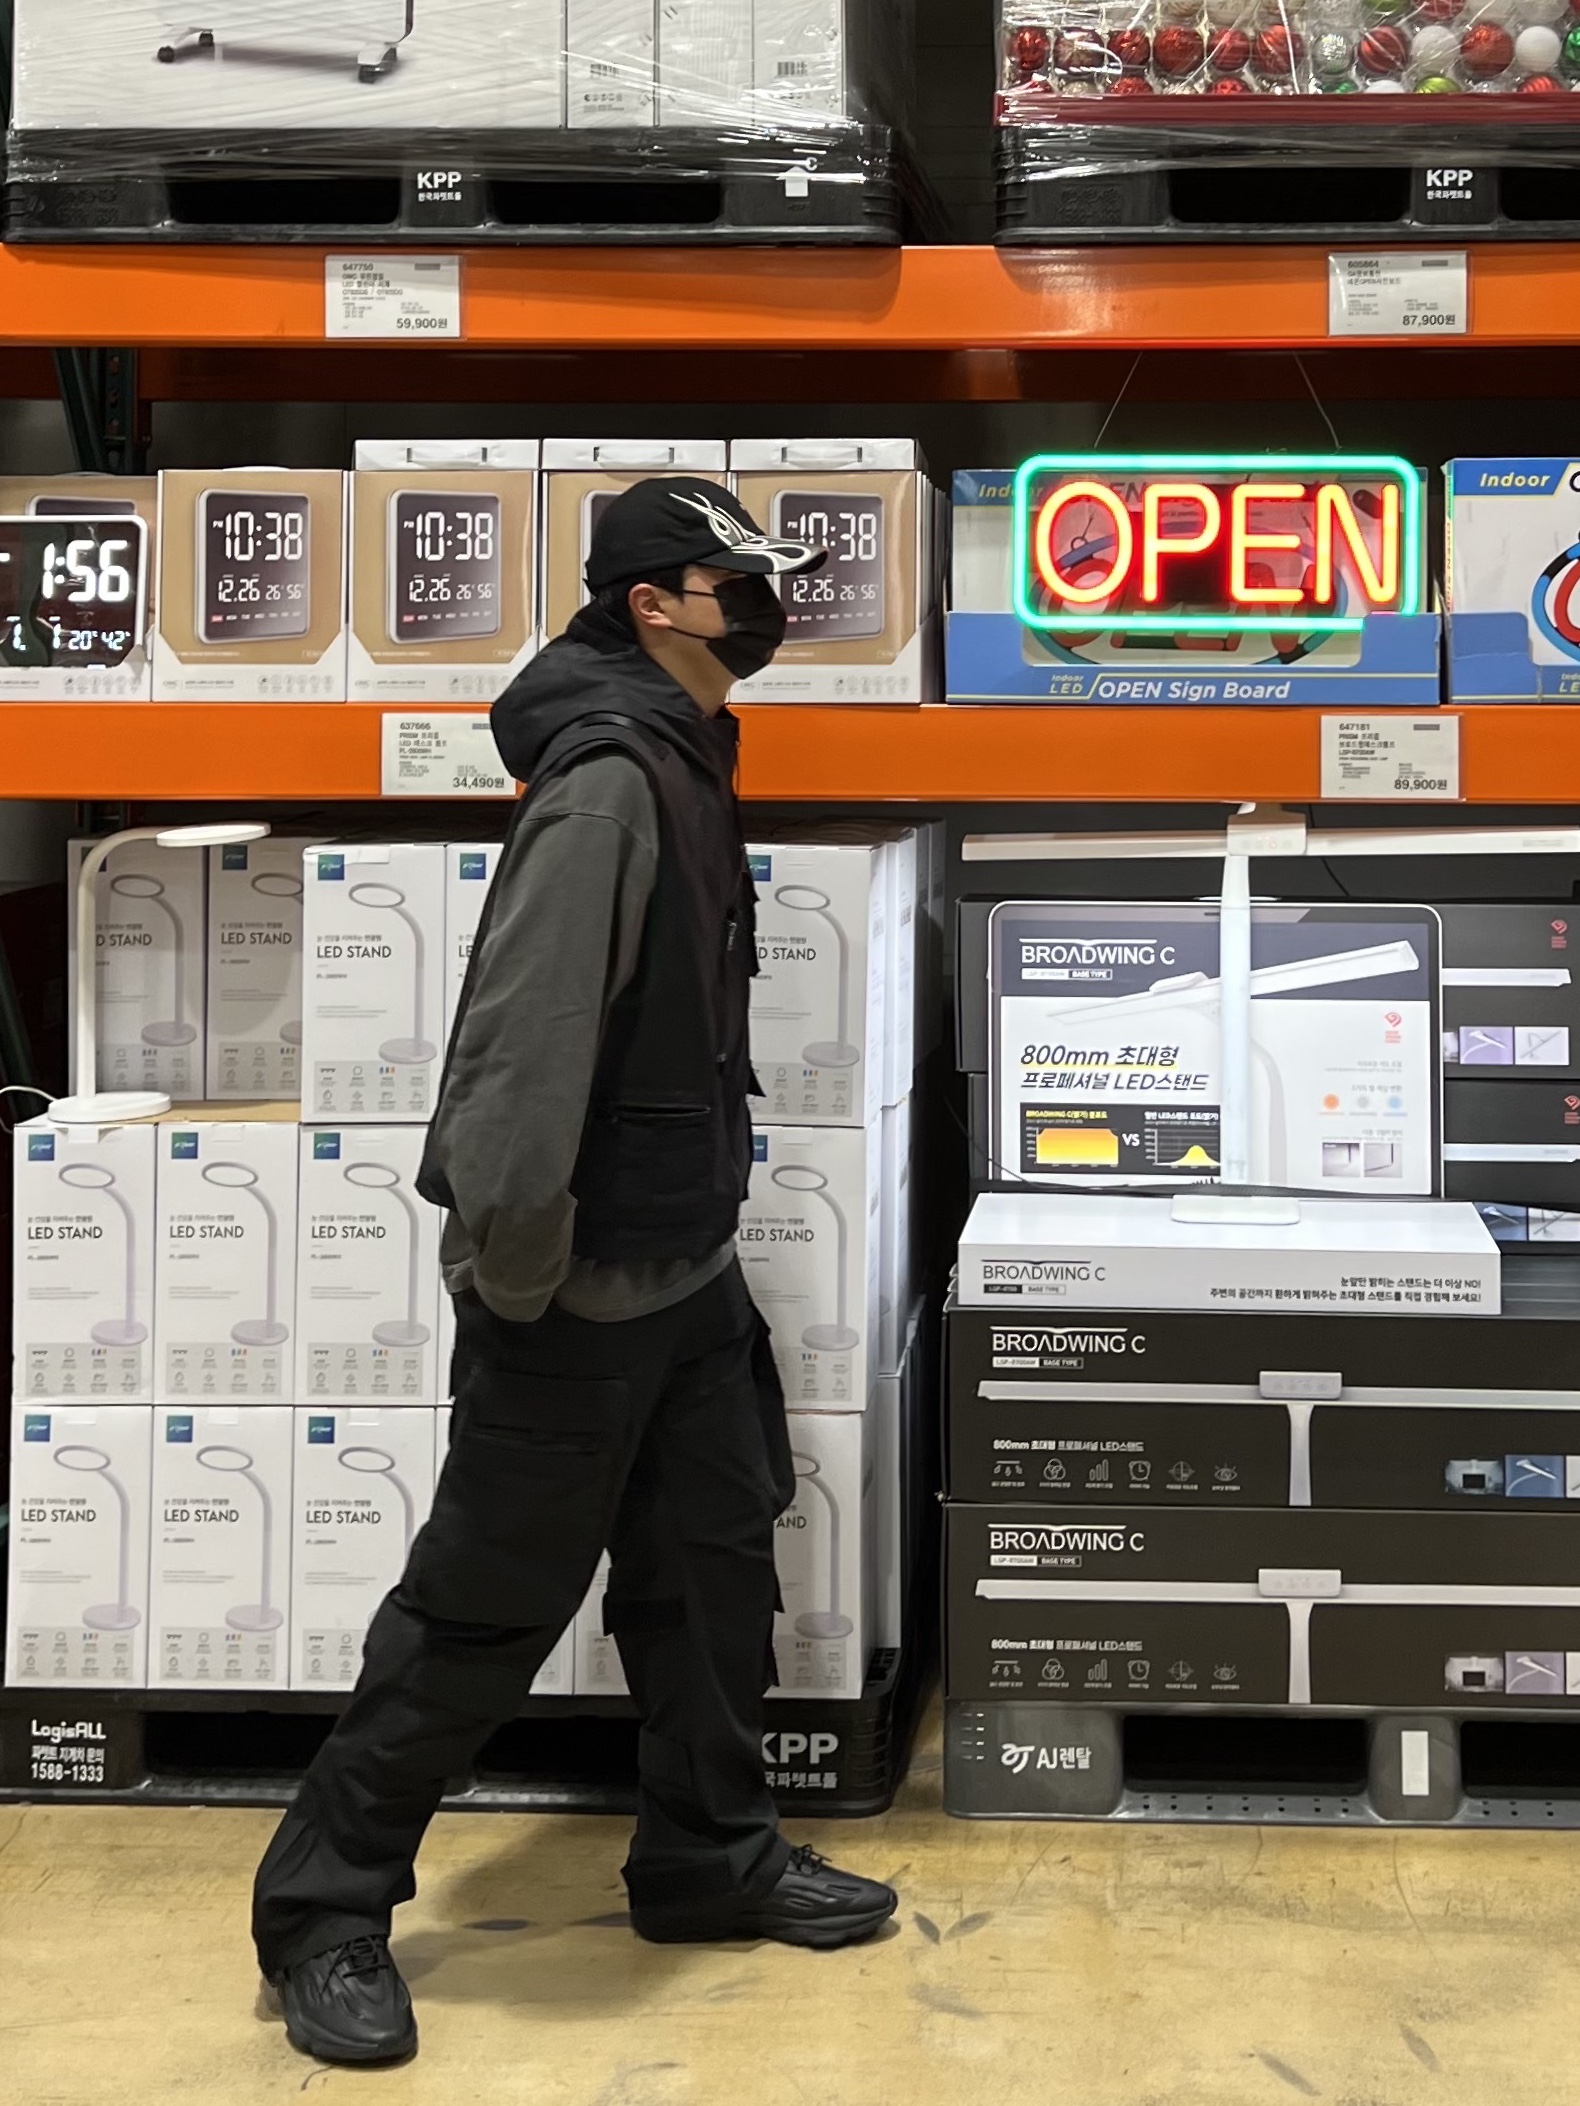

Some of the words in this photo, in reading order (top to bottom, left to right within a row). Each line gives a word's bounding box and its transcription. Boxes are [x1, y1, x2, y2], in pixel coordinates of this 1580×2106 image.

[417, 171, 462, 189] KPP
[1426, 169, 1473, 187] KPP
[396, 318, 448, 330] 59,900원
[1402, 314, 1456, 327] 87,900원
[1479, 472, 1551, 487] Indoor
[225, 511, 303, 561] 10:38
[416, 511, 494, 561] 10:38
[1035, 480, 1399, 604] OPEN
[1049, 683, 1084, 694] LED
[1098, 681, 1163, 698] OPEN
[1167, 681, 1216, 701] Sign
[1222, 681, 1291, 699] Board
[453, 777, 505, 789] 34,490원
[1394, 779, 1447, 791] 89,900원
[109, 933, 153, 947] STAND
[221, 932, 245, 945] LED
[250, 932, 292, 945] STAND
[317, 945, 343, 959] LED
[347, 945, 392, 959] STAND
[772, 947, 817, 961] STAND
[1159, 947, 1176, 965] C
[1020, 1044, 1109, 1065] 800mm
[1115, 1045, 1179, 1067] 초대형
[1021, 1072, 1110, 1090] 프로페셔널
[1113, 1073, 1209, 1091] LED스탠드
[1122, 1133, 1140, 1147] VS
[28, 1226, 53, 1239] LED
[58, 1226, 103, 1239] STAND
[169, 1225, 195, 1238] LED
[200, 1225, 244, 1238] STAND
[311, 1225, 337, 1239] LED
[341, 1225, 386, 1239] STAND
[740, 1228, 765, 1242] LED
[769, 1228, 814, 1242] STAND
[1094, 1267, 1106, 1281] C
[1397, 1278, 1431, 1288] 스탠드는
[1434, 1279, 1442, 1289] 더
[1445, 1279, 1462, 1289] 이상
[1210, 1288, 1236, 1298] 주변의
[1239, 1288, 1272, 1299] 공간까지
[1368, 1291, 1402, 1302] 스탠드를
[1452, 1292, 1481, 1302] 보세요!
[1131, 1335, 1146, 1353] C
[993, 1439, 1029, 1450] 800mm
[21, 1509, 46, 1522] LED
[51, 1509, 96, 1522] STAND
[164, 1509, 190, 1523] LED
[194, 1509, 239, 1523] STAND
[306, 1510, 332, 1524] LED
[336, 1510, 381, 1524] STAND
[1129, 1533, 1144, 1552] C
[991, 1639, 1028, 1650] 800mm
[31, 1719, 107, 1744] LogisALL
[1036, 1747, 1093, 1770] AJ렌탈
[31, 1762, 104, 1782] 1588-1333
